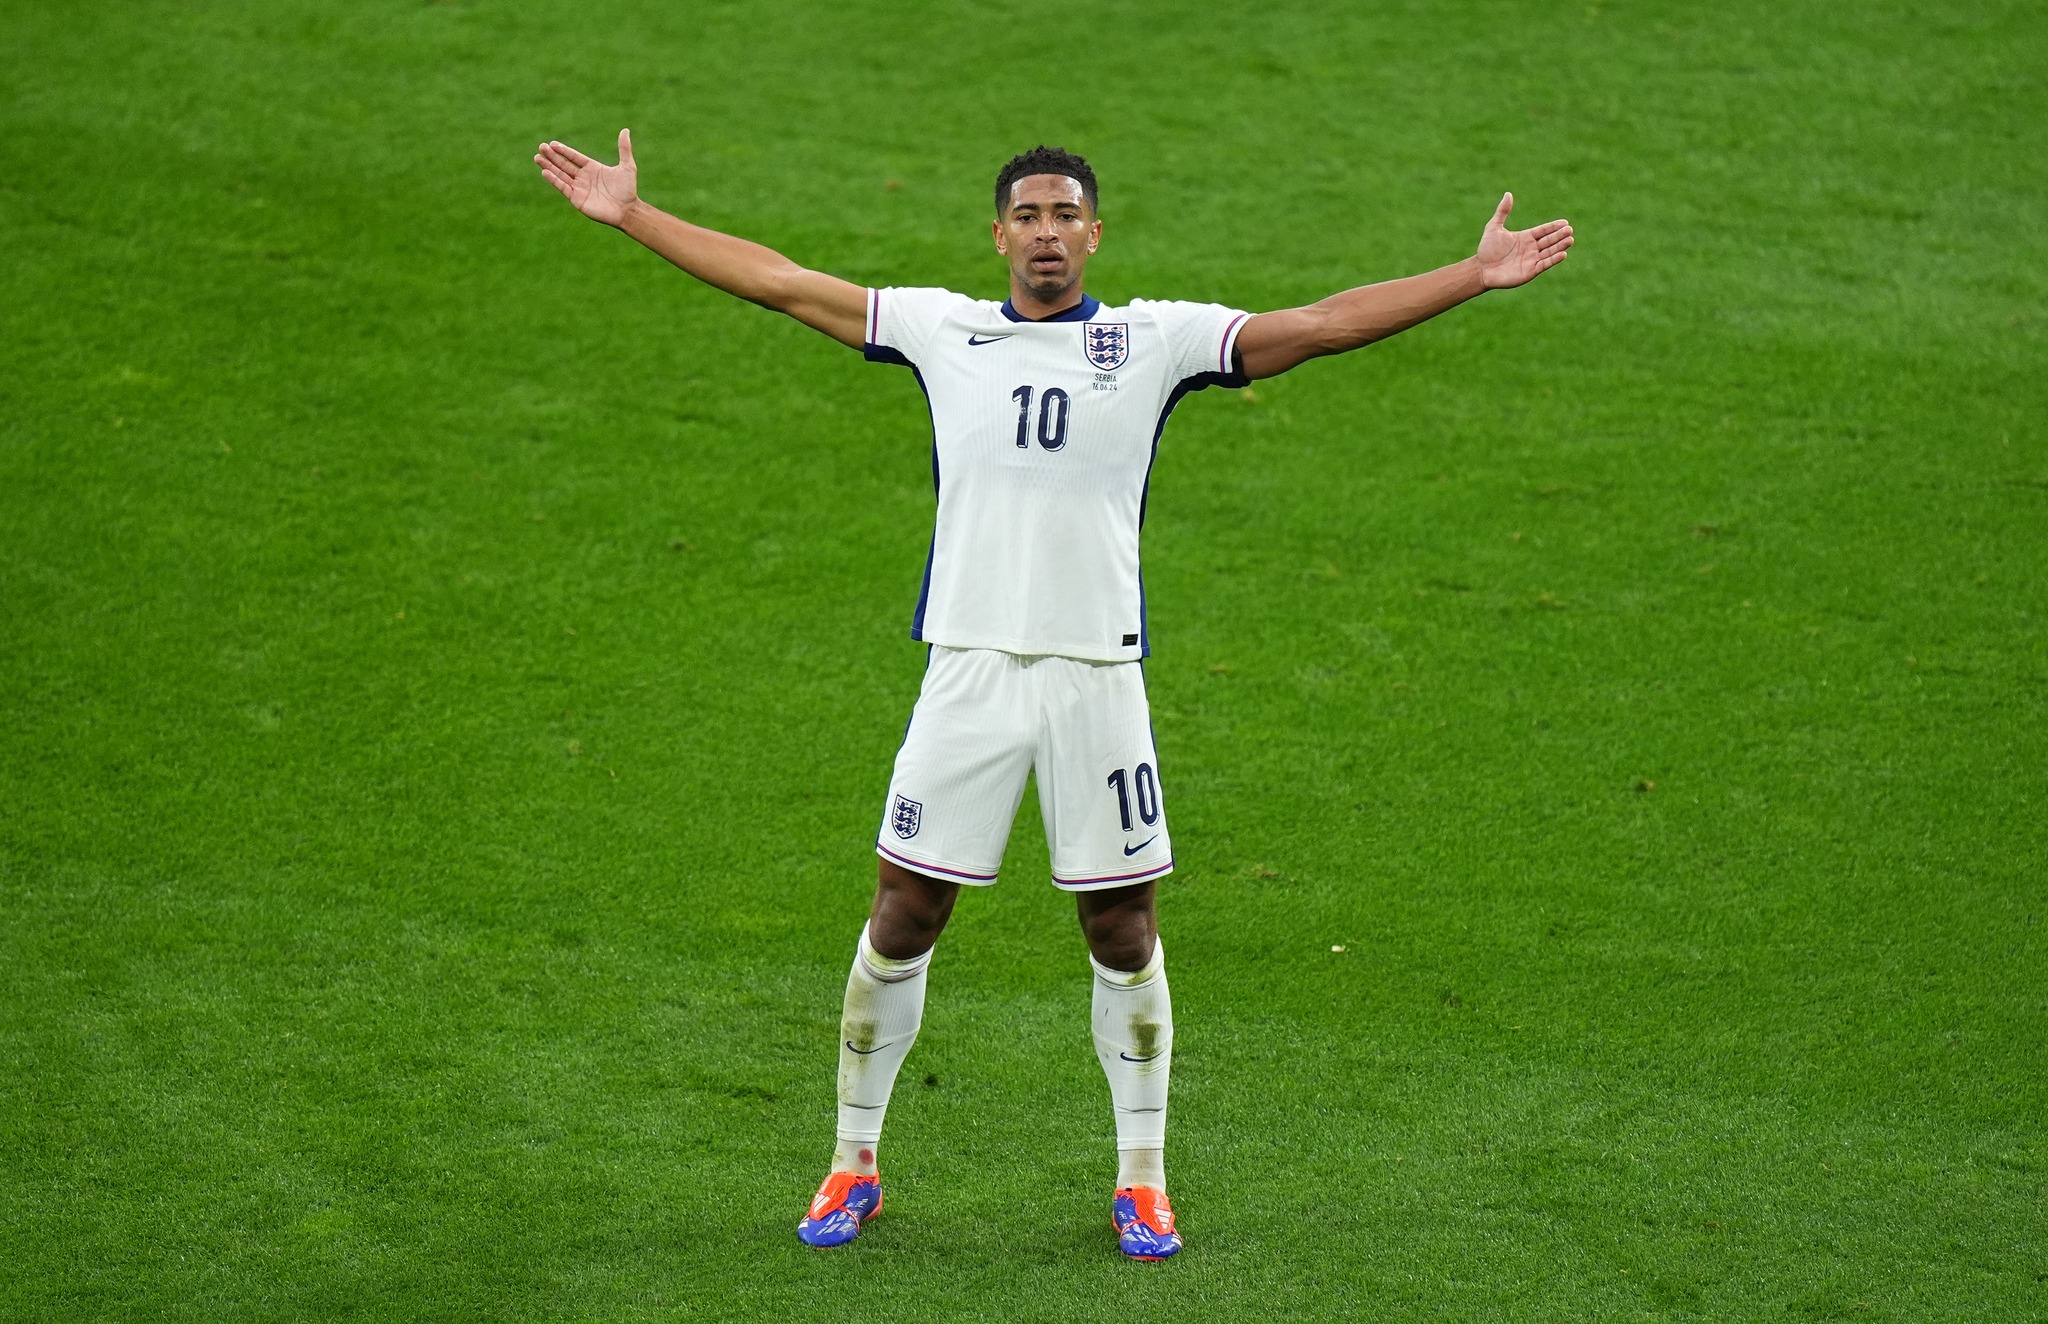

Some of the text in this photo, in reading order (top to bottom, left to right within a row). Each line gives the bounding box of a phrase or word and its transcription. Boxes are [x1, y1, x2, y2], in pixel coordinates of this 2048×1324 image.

[1094, 373, 1117, 382] SERBIA
[1011, 385, 1071, 452] 10
[1107, 762, 1160, 832] 10
